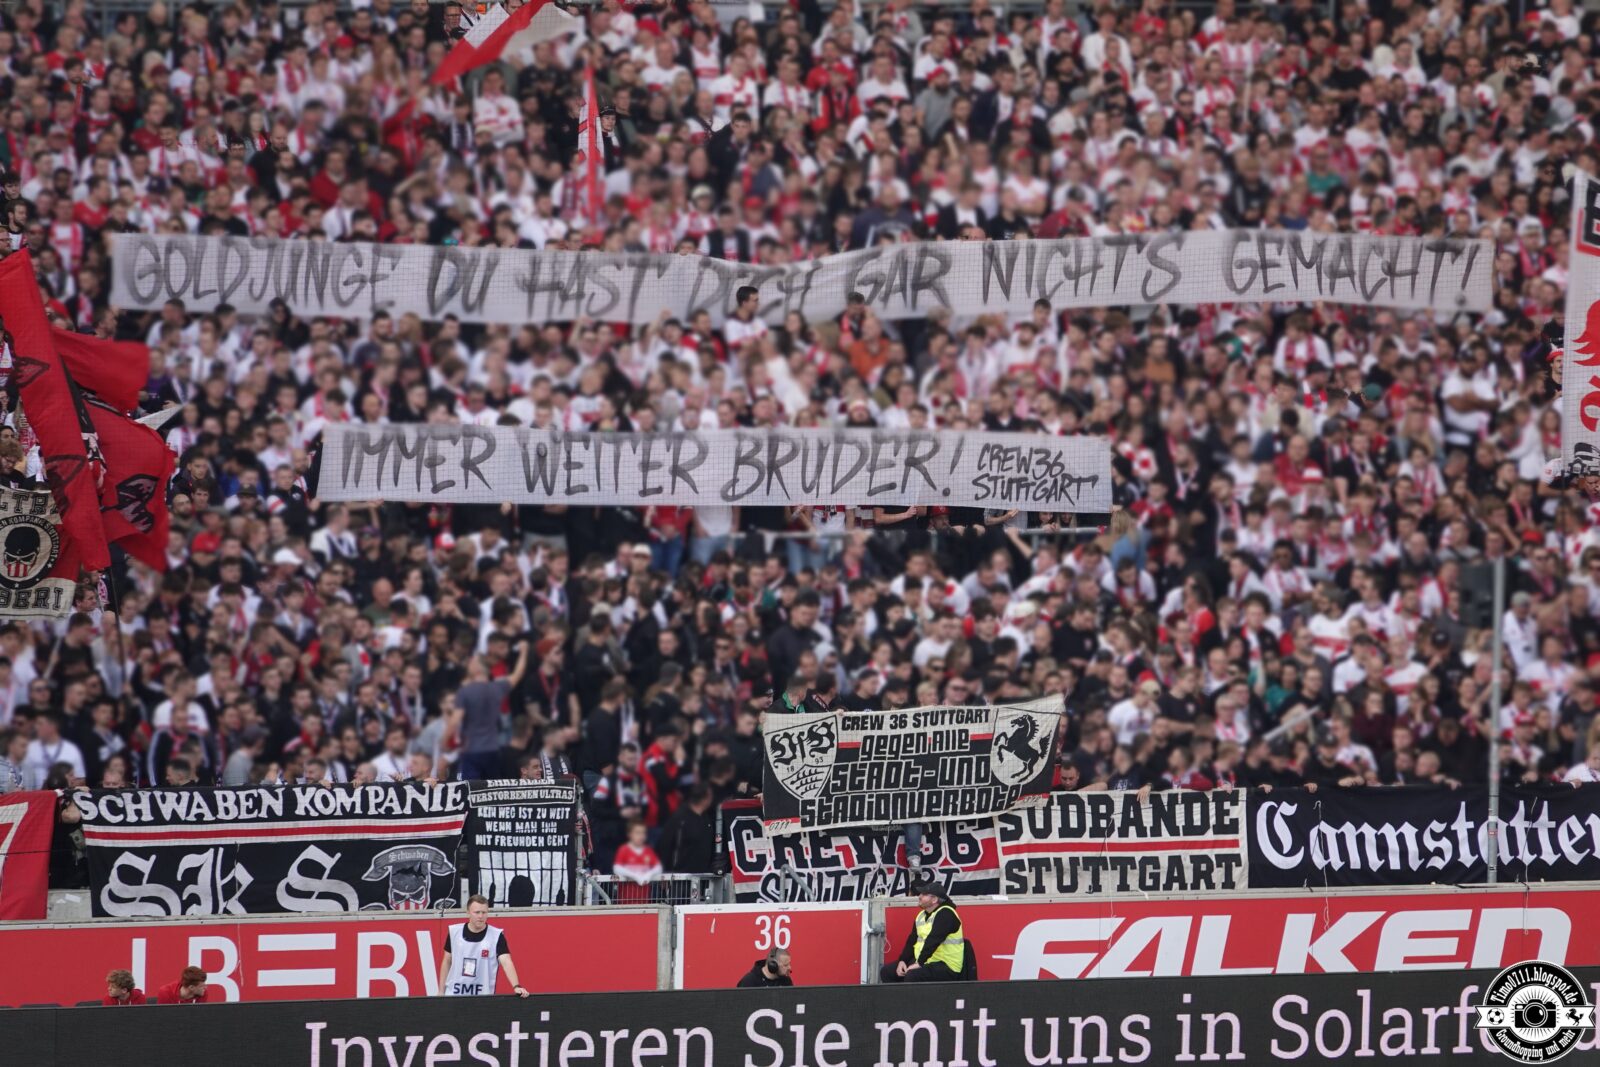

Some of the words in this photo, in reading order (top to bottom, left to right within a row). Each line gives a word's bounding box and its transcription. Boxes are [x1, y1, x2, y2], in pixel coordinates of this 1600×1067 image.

[127, 234, 400, 308] GOLDJUNGE
[427, 245, 498, 313] DU
[843, 243, 952, 311] GAR
[1222, 230, 1480, 306] GEMACHT!
[341, 427, 497, 494] IMMER
[517, 428, 709, 496] WEITER
[720, 430, 964, 501] BRUDER!
[972, 474, 1098, 505] STUTTGART
[841, 715, 884, 731] CREW
[889, 713, 907, 729] 36
[912, 708, 991, 728] STUTTGART
[73, 787, 284, 824] SCHWABEN
[291, 781, 468, 817] KOMPANIE
[470, 790, 538, 803] VERSTORBENEN
[539, 789, 574, 800] ULTRAS
[477, 806, 497, 818] KEIN
[498, 806, 515, 818] WEG
[518, 807, 533, 819] IST
[536, 807, 547, 819] ZU
[549, 807, 571, 819] WEIT
[475, 834, 493, 846] MIT
[494, 835, 545, 847] FREUNDEN
[547, 834, 570, 847] GEHT
[485, 821, 512, 833] WENN
[515, 821, 538, 833] MAN
[1004, 853, 1242, 895] STUTTGART
[754, 914, 791, 950] 36
[991, 906, 1573, 981] FALKEN
[305, 1010, 716, 1067] Investieren
[744, 1004, 851, 1067] Sie
[873, 999, 997, 1067] mit
[1020, 1012, 1152, 1066] uns
[1174, 993, 1247, 1062] in
